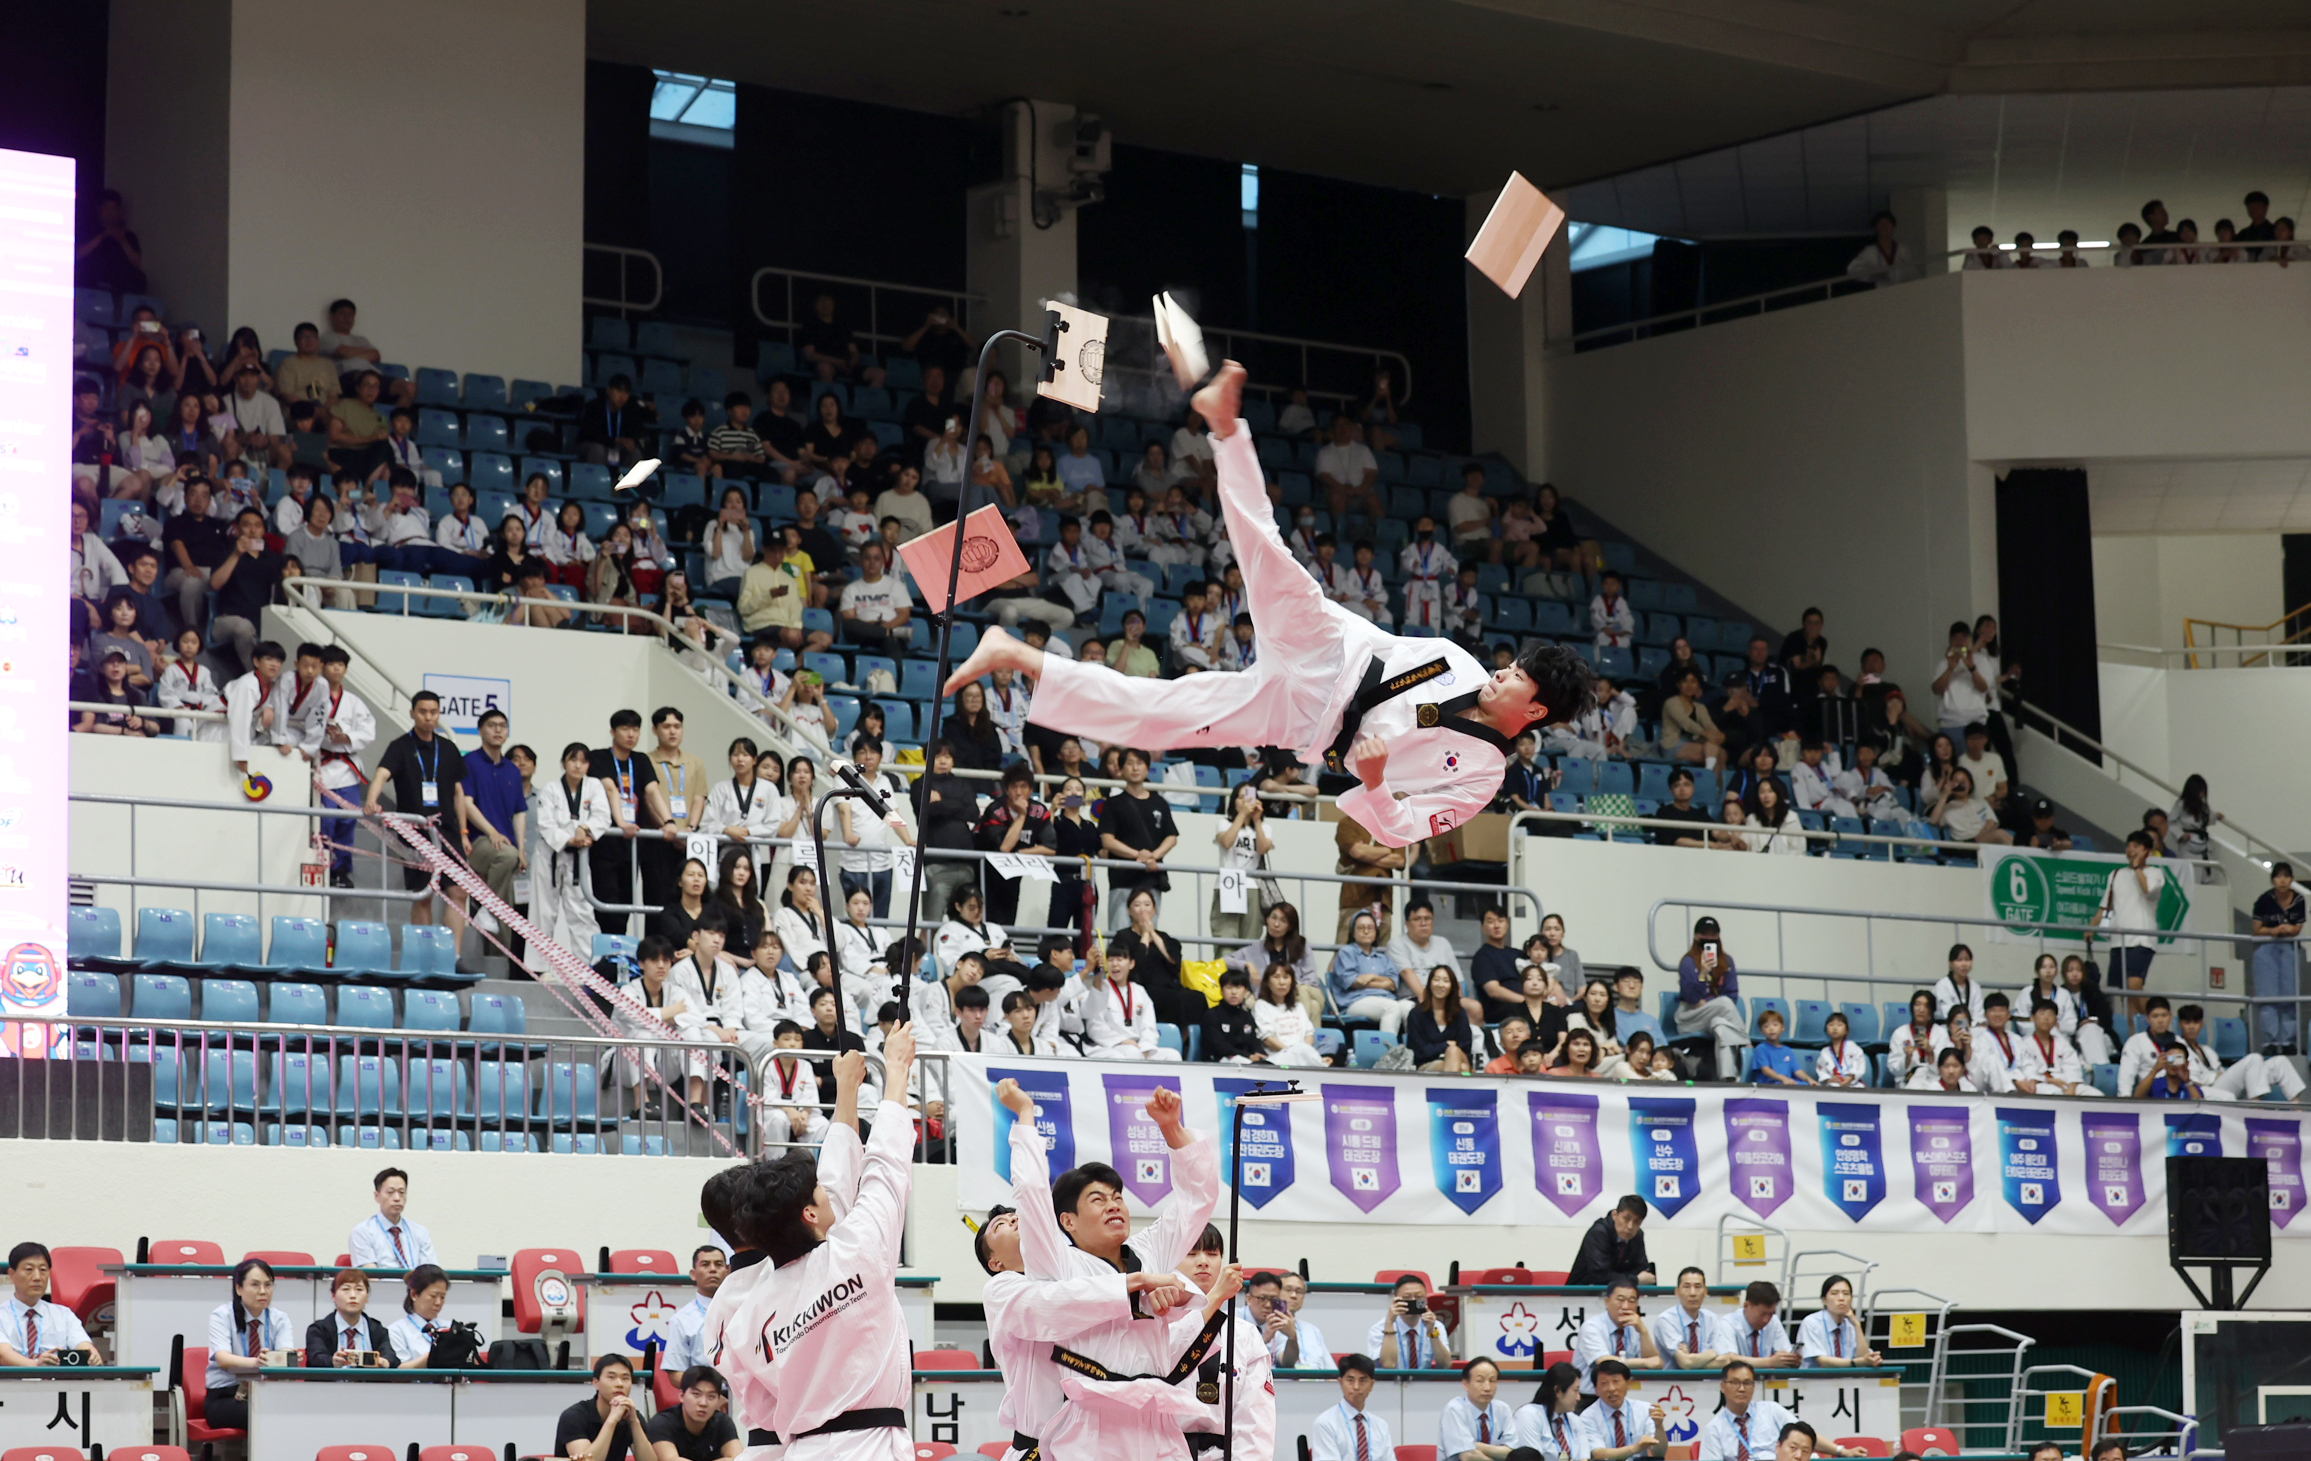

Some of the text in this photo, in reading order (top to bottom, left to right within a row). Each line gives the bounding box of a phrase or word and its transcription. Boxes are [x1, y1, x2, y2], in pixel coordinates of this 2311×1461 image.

[485, 694, 498, 711] 5
[1223, 872, 1244, 899] 아
[2009, 862, 2028, 904] 6
[2006, 907, 2034, 922] GATE
[1128, 1125, 1146, 1138] 성남
[1252, 1129, 1279, 1143] 경희대
[1129, 1140, 1168, 1154] 태권도장
[1362, 1135, 1381, 1149] 드림
[1248, 1144, 1285, 1158] 태권도장
[1343, 1149, 1381, 1163] 태권도장
[1448, 1152, 1486, 1165] 태권도장
[1549, 1154, 1586, 1168] 태권도장
[1649, 1158, 1684, 1171] 태권도장
[2026, 1167, 2054, 1180] 태권도장
[2099, 1170, 2128, 1182] 태권도장
[804, 1302, 850, 1334] Demonstration
[850, 1290, 868, 1305] Team
[1556, 1307, 1585, 1351] 성
[1832, 1388, 1860, 1433] 시
[46, 1392, 90, 1449] 시
[927, 1392, 965, 1444] 남
